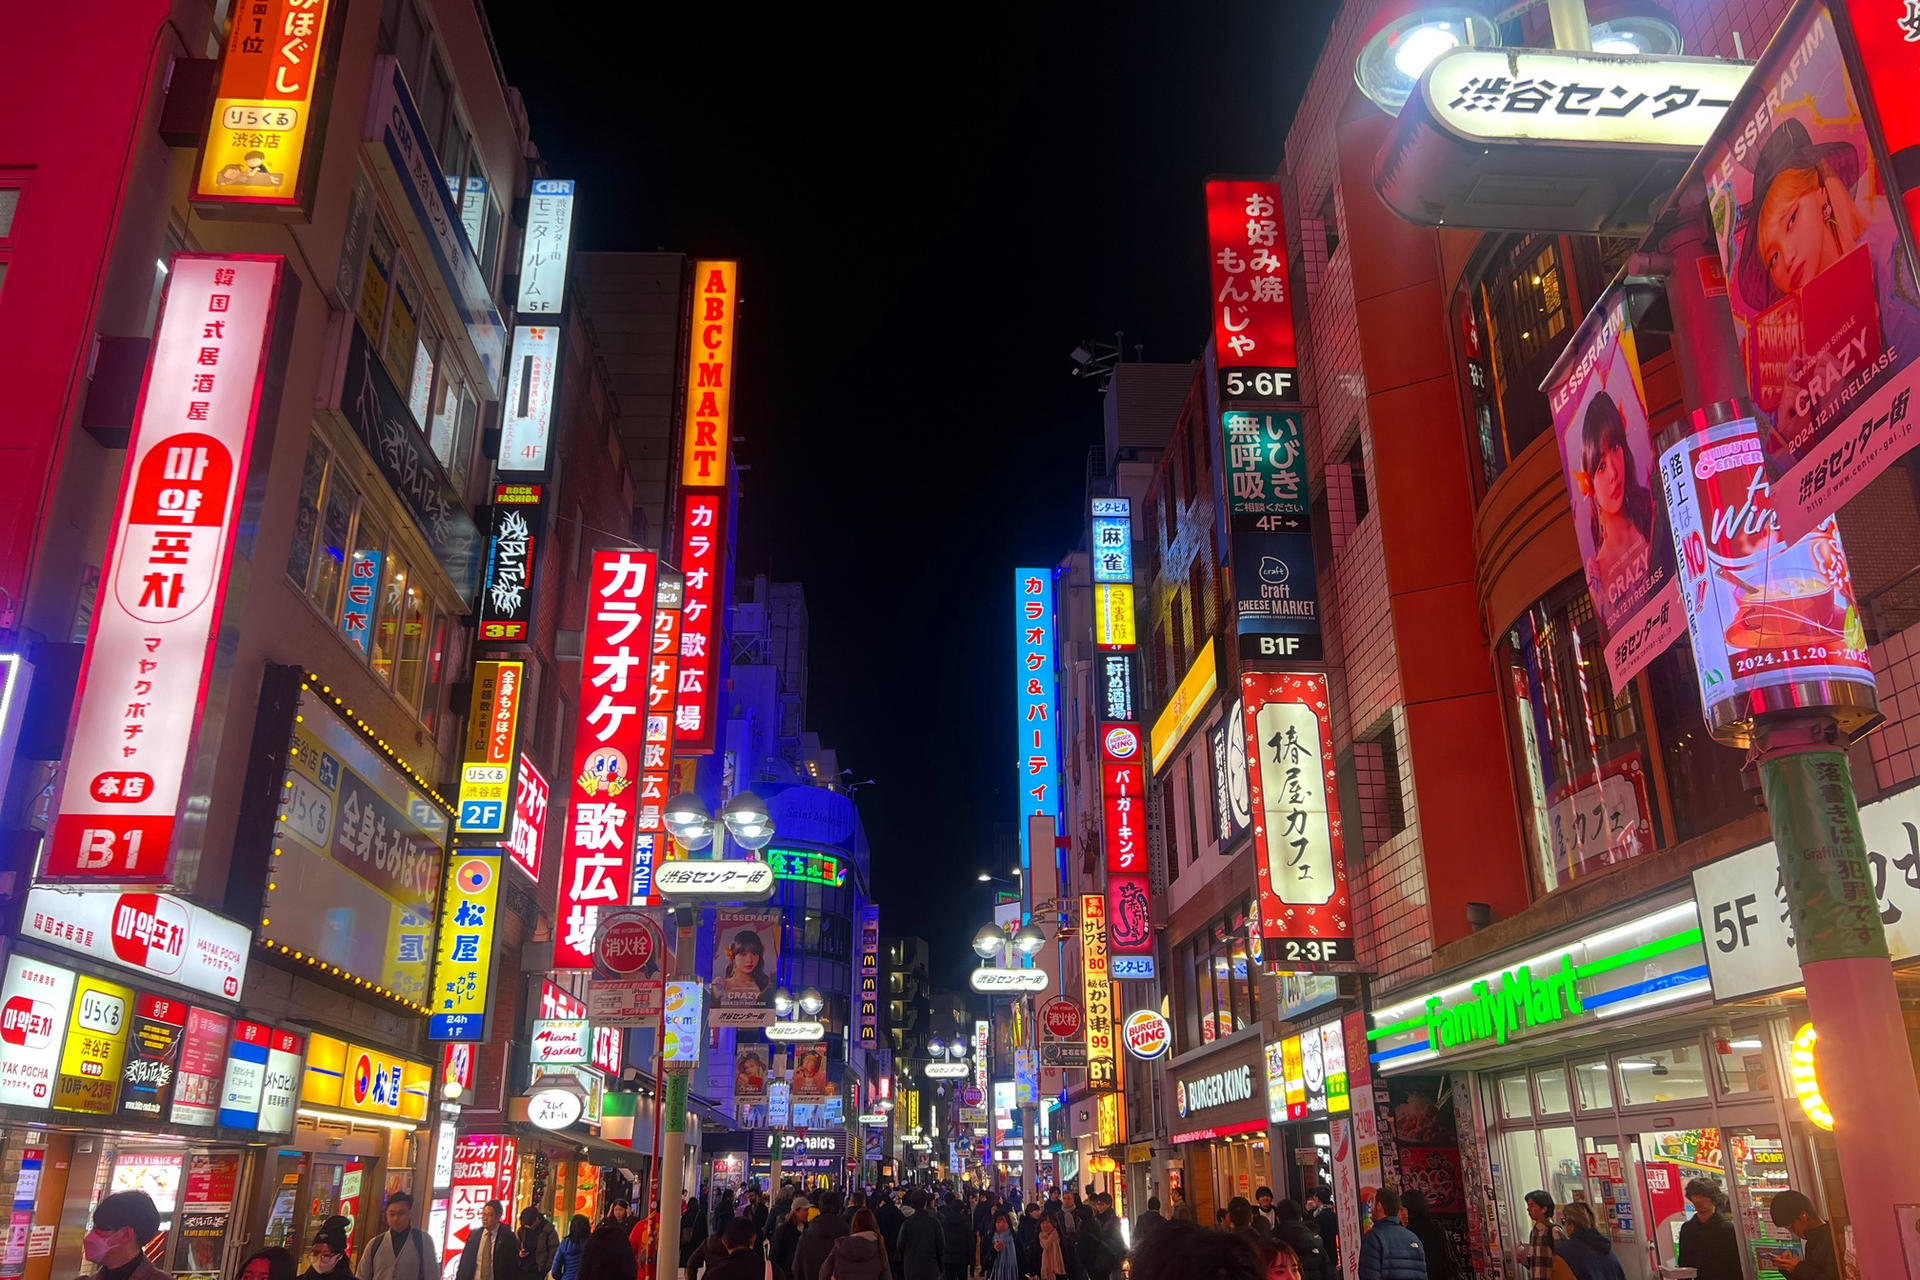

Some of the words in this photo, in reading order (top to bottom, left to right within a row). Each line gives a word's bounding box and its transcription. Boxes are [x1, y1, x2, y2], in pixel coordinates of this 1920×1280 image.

[1448, 76, 1734, 120] 渋谷センター
[1709, 152, 1735, 196] LE
[1735, 18, 1825, 162] SSERAFIM
[231, 111, 290, 127] りらくる
[232, 132, 281, 149] 渋谷店
[536, 182, 570, 193] CBR
[525, 198, 552, 296] モニタールーム
[1245, 192, 1284, 303] お好み焼
[529, 302, 550, 312] 5F
[186, 267, 237, 421] 韓国式居酒屋
[1831, 315, 1857, 346] SINGLE
[1553, 382, 1570, 415] LE
[1569, 304, 1624, 394] SSERAFIM
[1796, 327, 1868, 418] CRAZY
[1788, 399, 1841, 455] 2024.12.11
[1841, 345, 1899, 402] RELEASE
[521, 445, 543, 459] 4F
[1229, 413, 1266, 500] 無呼吸
[1265, 414, 1301, 500] いびき
[1799, 387, 1911, 505] 渋谷センター街
[498, 494, 539, 503] FASHION
[505, 487, 533, 495] ROCK
[1093, 503, 1129, 513] センタービル
[1234, 502, 1304, 514] ご相談ください
[138, 446, 209, 610] 마약포차
[1256, 516, 1282, 531] 4F
[1102, 527, 1123, 571] 麻雀
[1682, 530, 1706, 582] NO
[1260, 583, 1290, 599] Craft
[1607, 553, 1650, 605] CRAZY
[1634, 566, 1664, 602] RELEASE
[676, 505, 714, 732] カラオケ歌広場
[1238, 601, 1270, 611] CHEESE
[1271, 601, 1315, 616] MARKET
[485, 624, 522, 637] 3F
[588, 552, 647, 742] カラオケ
[649, 612, 674, 707] カラオケ
[1260, 637, 1300, 656] B1F
[1736, 646, 1827, 673] 2024.11.20
[1106, 656, 1126, 720] 一軒め酒場
[494, 669, 516, 760] 全身もみほぐし
[1110, 734, 1132, 744] BURGER
[1111, 740, 1134, 751] KING
[97, 775, 146, 798] 本店
[467, 769, 504, 781] りらくる
[639, 745, 666, 830] 歌広場
[465, 786, 503, 798] 渋谷店
[1267, 725, 1315, 881] 椿屋カフェ
[466, 804, 497, 825] 2F
[1115, 770, 1135, 869] バーガーキング
[77, 827, 144, 869] B1
[339, 789, 437, 905] 全身もみほぐし
[1815, 762, 1876, 945] 落書きは犯罪です
[565, 802, 627, 957] 歌広場
[661, 870, 769, 884] 渋谷センター街
[33, 911, 95, 948] 韓国式居酒屋
[115, 903, 186, 958] 마약포차
[451, 900, 487, 963] 松屋
[719, 913, 732, 922] LE
[732, 913, 780, 923] SSERAFIM
[1713, 893, 1759, 953] 5F
[196, 937, 220, 957] MAYAK
[220, 946, 242, 964] POCHA
[606, 937, 649, 957] 消火栓
[1084, 921, 1095, 957] サワー
[1096, 918, 1107, 956] レモン
[1088, 957, 1104, 970] 80
[1113, 960, 1153, 973] センタービル
[456, 976, 466, 1005] カレー
[466, 971, 478, 1001] 牛めし
[976, 974, 1045, 985] 渋谷センター街
[444, 982, 456, 1009] 定食
[728, 991, 761, 1000] CRAZY
[1426, 953, 1583, 1051] FamilyMart
[3, 1008, 53, 1038] 마약포차
[84, 997, 120, 1026] りらくる
[446, 1015, 468, 1024] 24h
[1049, 1012, 1078, 1027] 消火栓
[1088, 989, 1108, 1032] かわ串
[448, 1028, 463, 1037] 1F
[535, 1031, 578, 1043] Miami
[1128, 1019, 1163, 1036] BURGER
[1130, 1026, 1164, 1049] KING
[81, 1037, 111, 1060] 渋谷店
[1090, 1035, 1110, 1049] 99
[20, 1062, 49, 1079] POCHA
[264, 1071, 297, 1093] メトロビル
[1090, 1061, 1114, 1080] B1
[372, 1063, 403, 1109] 松屋
[1188, 1073, 1224, 1112] BURGER
[1223, 1064, 1252, 1104] KING
[456, 1142, 499, 1160] カラオケ
[453, 1161, 497, 1180] 歌広場
[457, 1188, 490, 1205] 入口
[1648, 1181, 1667, 1190] ATM
